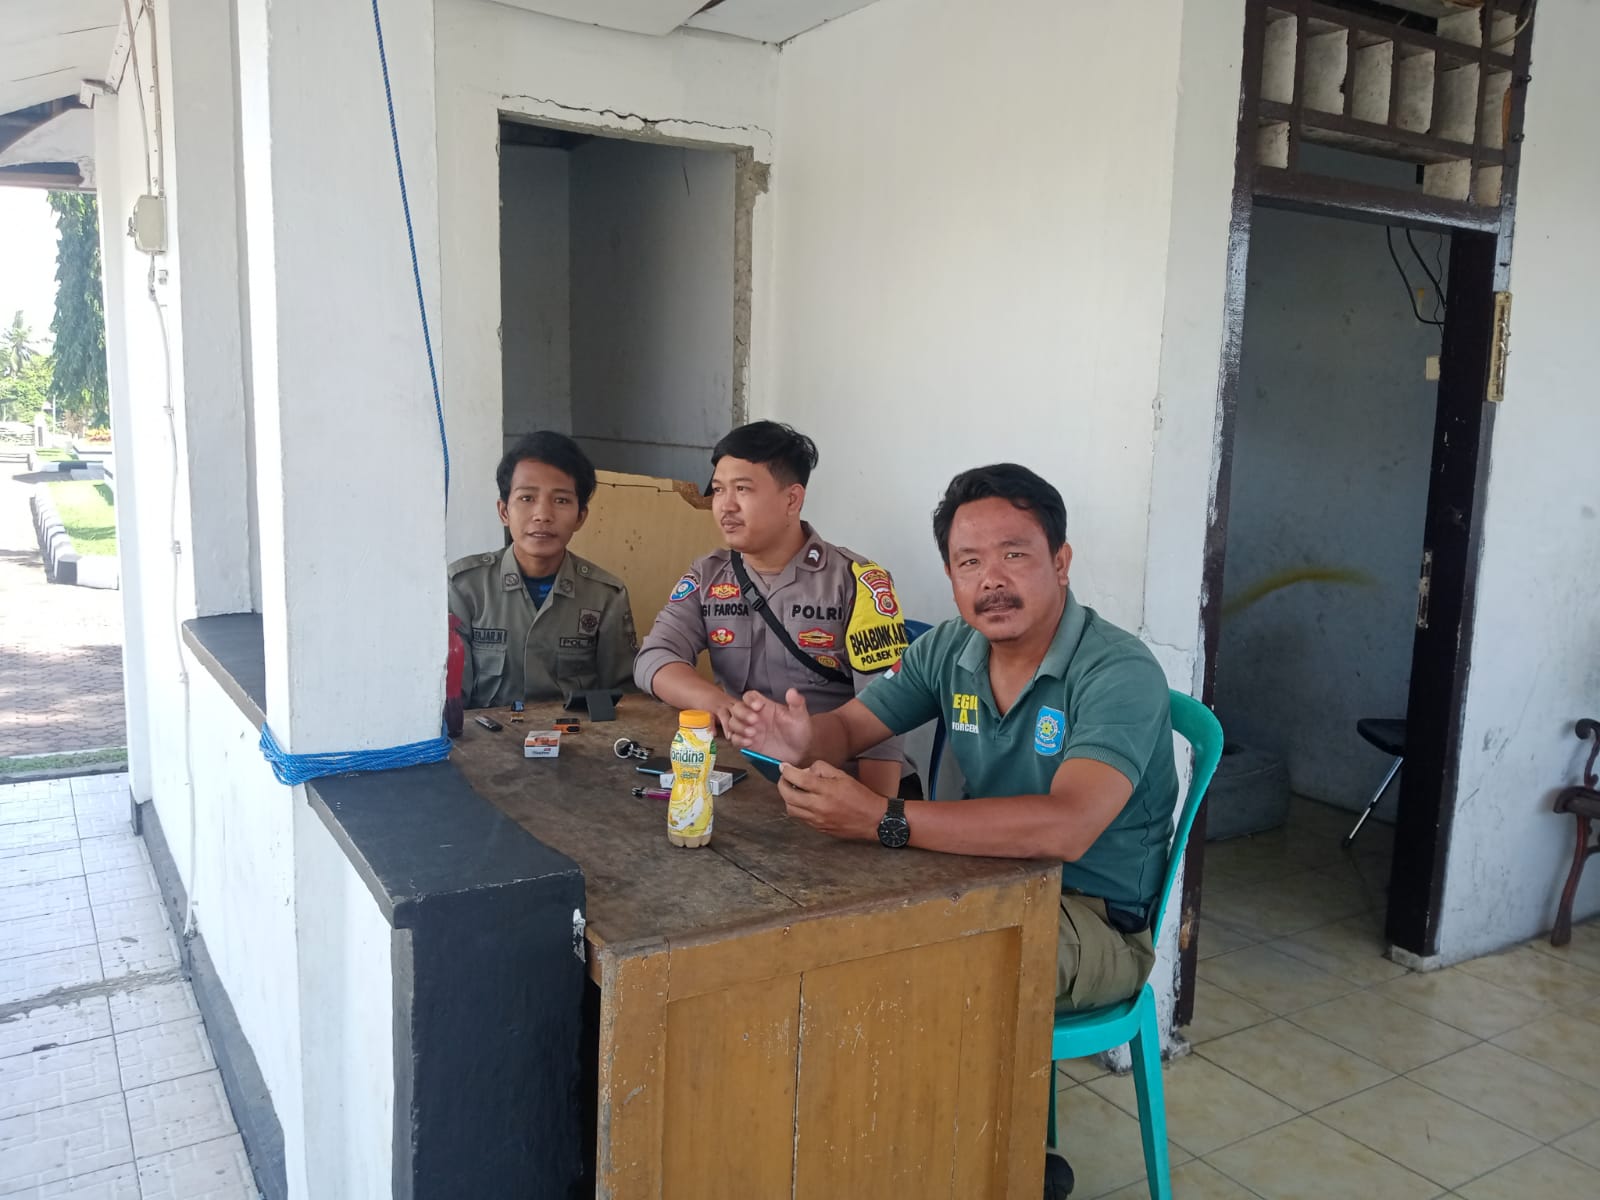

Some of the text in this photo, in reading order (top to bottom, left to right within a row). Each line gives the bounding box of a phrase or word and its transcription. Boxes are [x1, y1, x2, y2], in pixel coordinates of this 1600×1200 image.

[714, 602, 750, 617] FAROSA
[791, 604, 843, 621] POLRI
[860, 649, 893, 666] POLSEK
[959, 709, 969, 724] A
[671, 749, 705, 764] oridina
